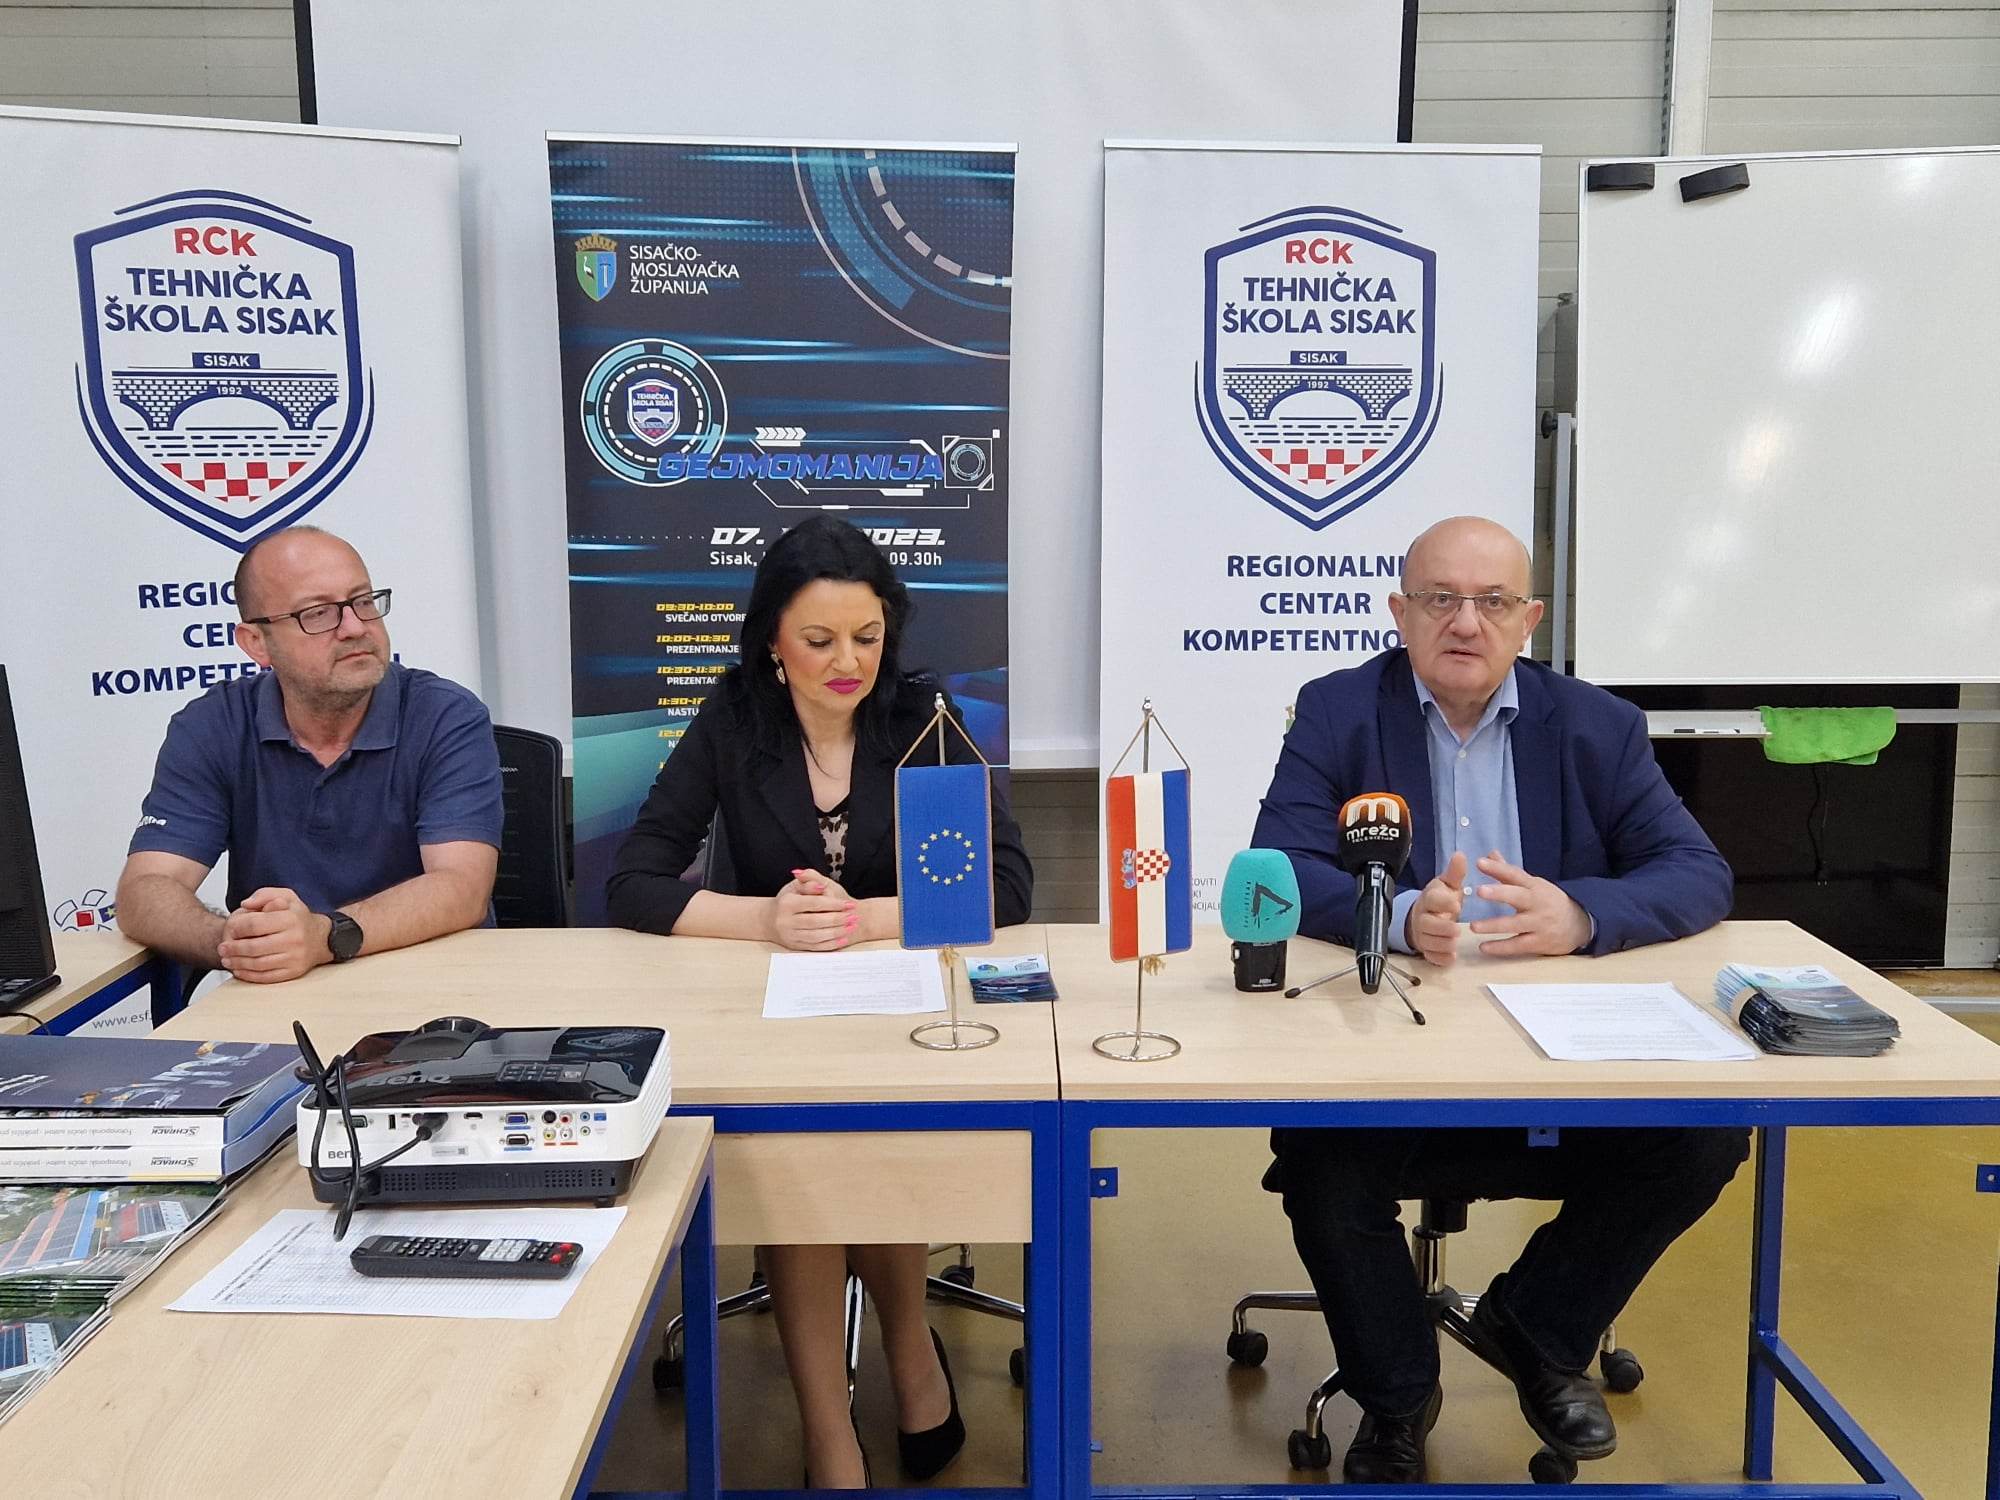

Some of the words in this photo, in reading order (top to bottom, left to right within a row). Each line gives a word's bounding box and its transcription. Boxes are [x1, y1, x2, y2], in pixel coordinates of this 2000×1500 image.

[174, 226, 257, 256] RCK
[629, 242, 702, 261] SISAČKO-
[1285, 238, 1353, 264] RCK
[630, 260, 740, 279] MOSLAVAČKA
[126, 264, 312, 300] TEHNIČKA
[630, 276, 709, 295] ŽUPANIJA
[1243, 271, 1397, 302] TEHNIČKA
[104, 295, 229, 333] ŠKOLA
[236, 307, 338, 335] SISAK
[1222, 302, 1323, 334] ŠKOLA
[1330, 309, 1416, 334] SISAK
[203, 354, 250, 367] SISAK
[1299, 353, 1338, 364] SISAK
[216, 386, 243, 395] 1992
[1307, 381, 1329, 389] 1992
[656, 452, 944, 481] GEJMOMANIJA
[710, 527, 765, 545] 07.
[864, 528, 946, 546] 023.
[710, 551, 758, 567] Sisak,
[889, 551, 942, 567] 09.30h
[1260, 592, 1371, 614] CENTAR
[665, 611, 709, 623] SVEČANO
[656, 634, 731, 643] 10:00-10:30
[1183, 629, 1403, 651] KOMPETENTNO
[666, 645, 740, 655] PREZENTIRANJE
[1346, 824, 1400, 841] mreža
[328, 1150, 363, 1159] Ben
